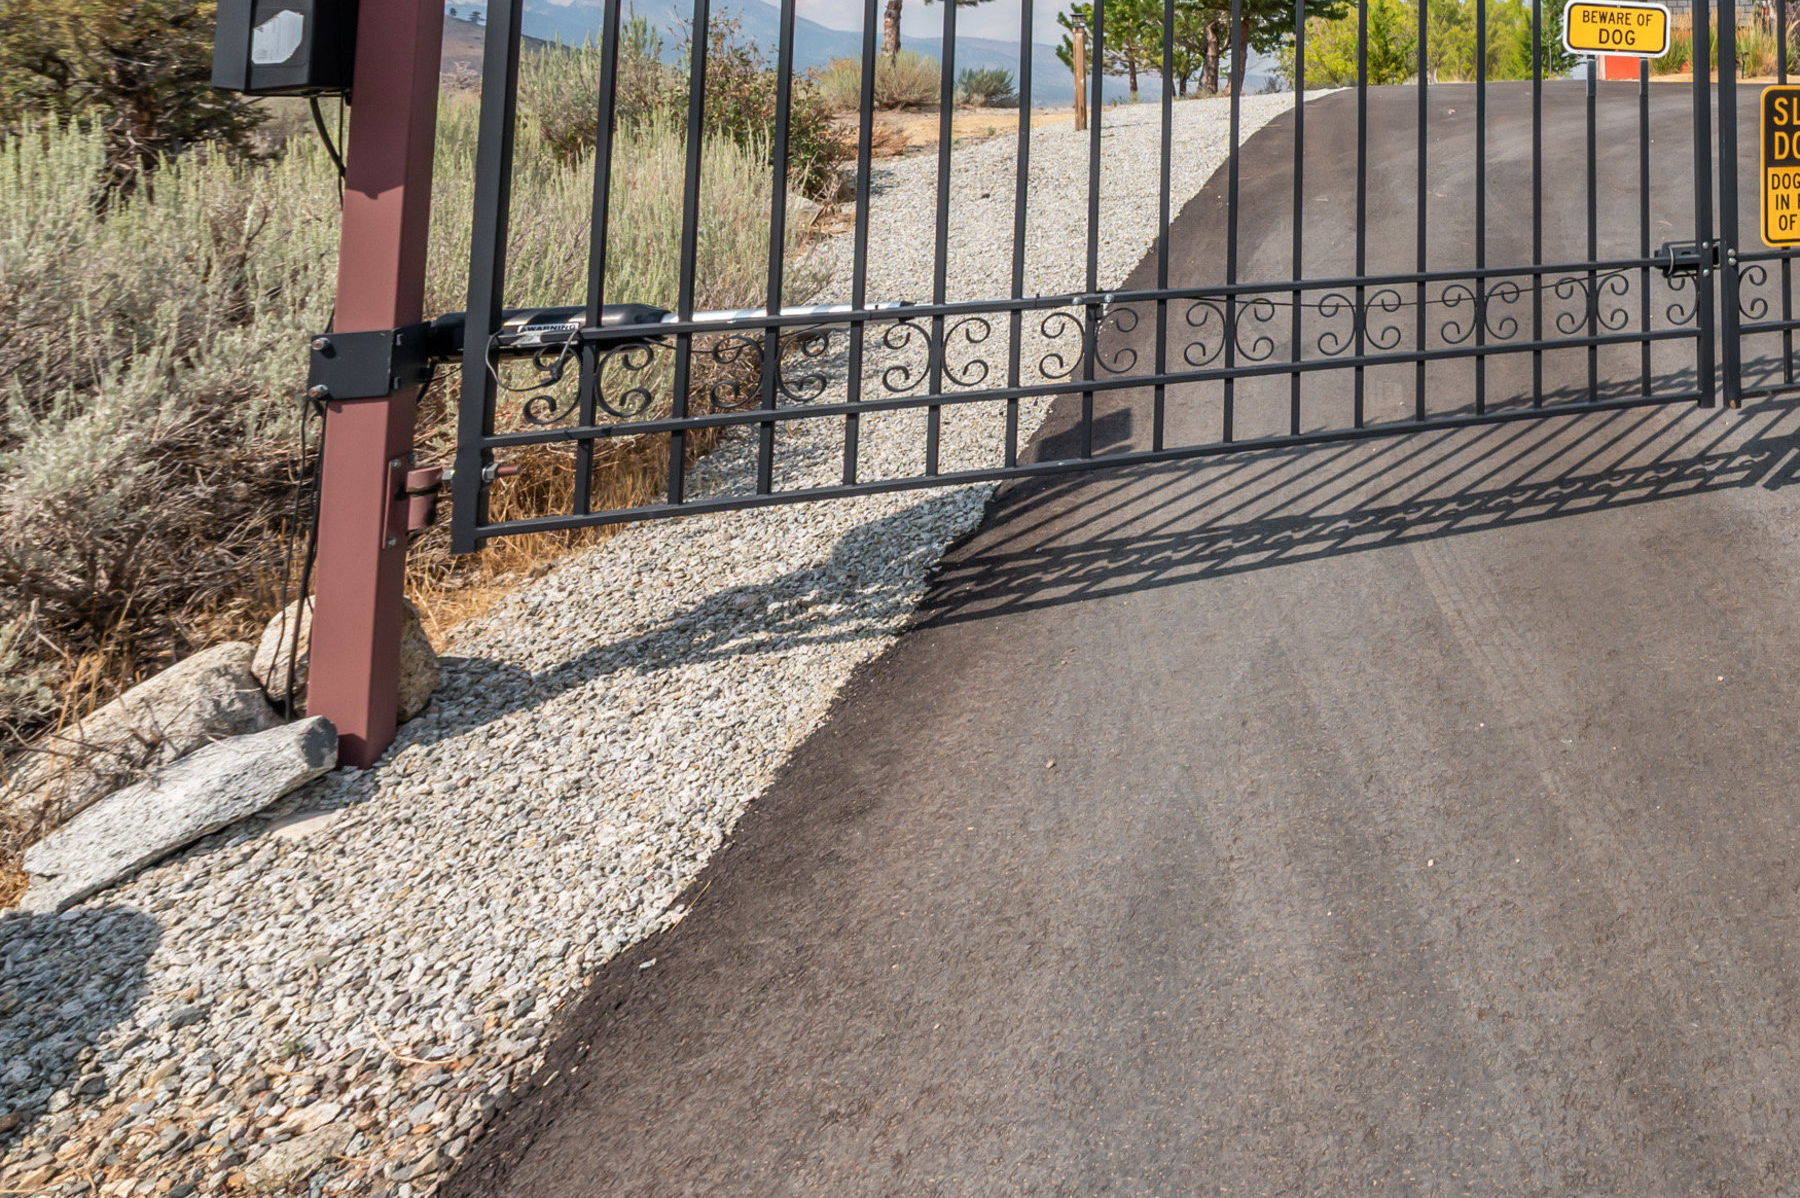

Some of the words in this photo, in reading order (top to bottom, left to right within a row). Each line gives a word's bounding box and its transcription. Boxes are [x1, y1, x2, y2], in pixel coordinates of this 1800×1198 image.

[1582, 10, 1632, 26] BEWARE
[1636, 14, 1653, 27] OF
[1598, 28, 1636, 46] DOG
[1771, 173, 1800, 190] DOG
[1775, 193, 1790, 211] IN
[1778, 214, 1797, 231] OF
[527, 324, 577, 332] WARNING
